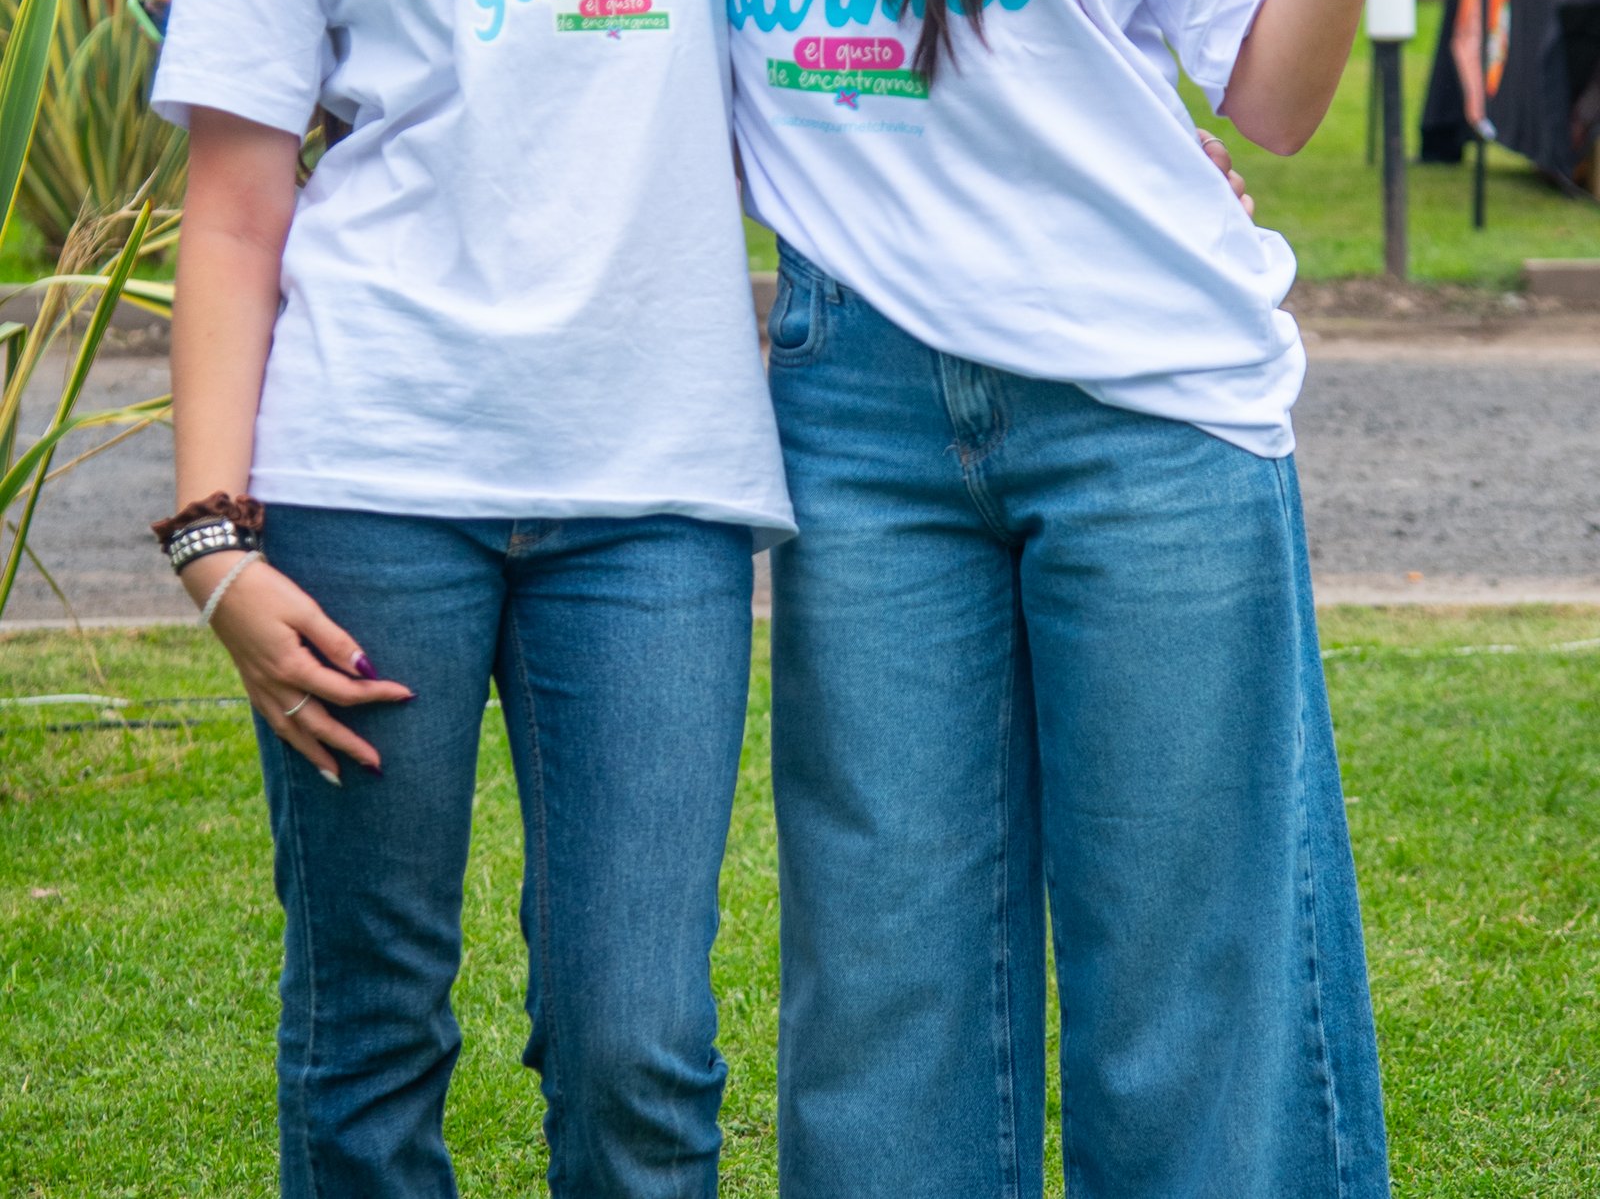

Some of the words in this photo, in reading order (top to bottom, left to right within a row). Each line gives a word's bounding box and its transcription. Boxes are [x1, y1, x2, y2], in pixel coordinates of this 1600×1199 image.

[803, 36, 826, 69] el
[836, 37, 893, 74] gusto
[767, 58, 790, 86] de
[798, 68, 925, 96] encontrarnos
